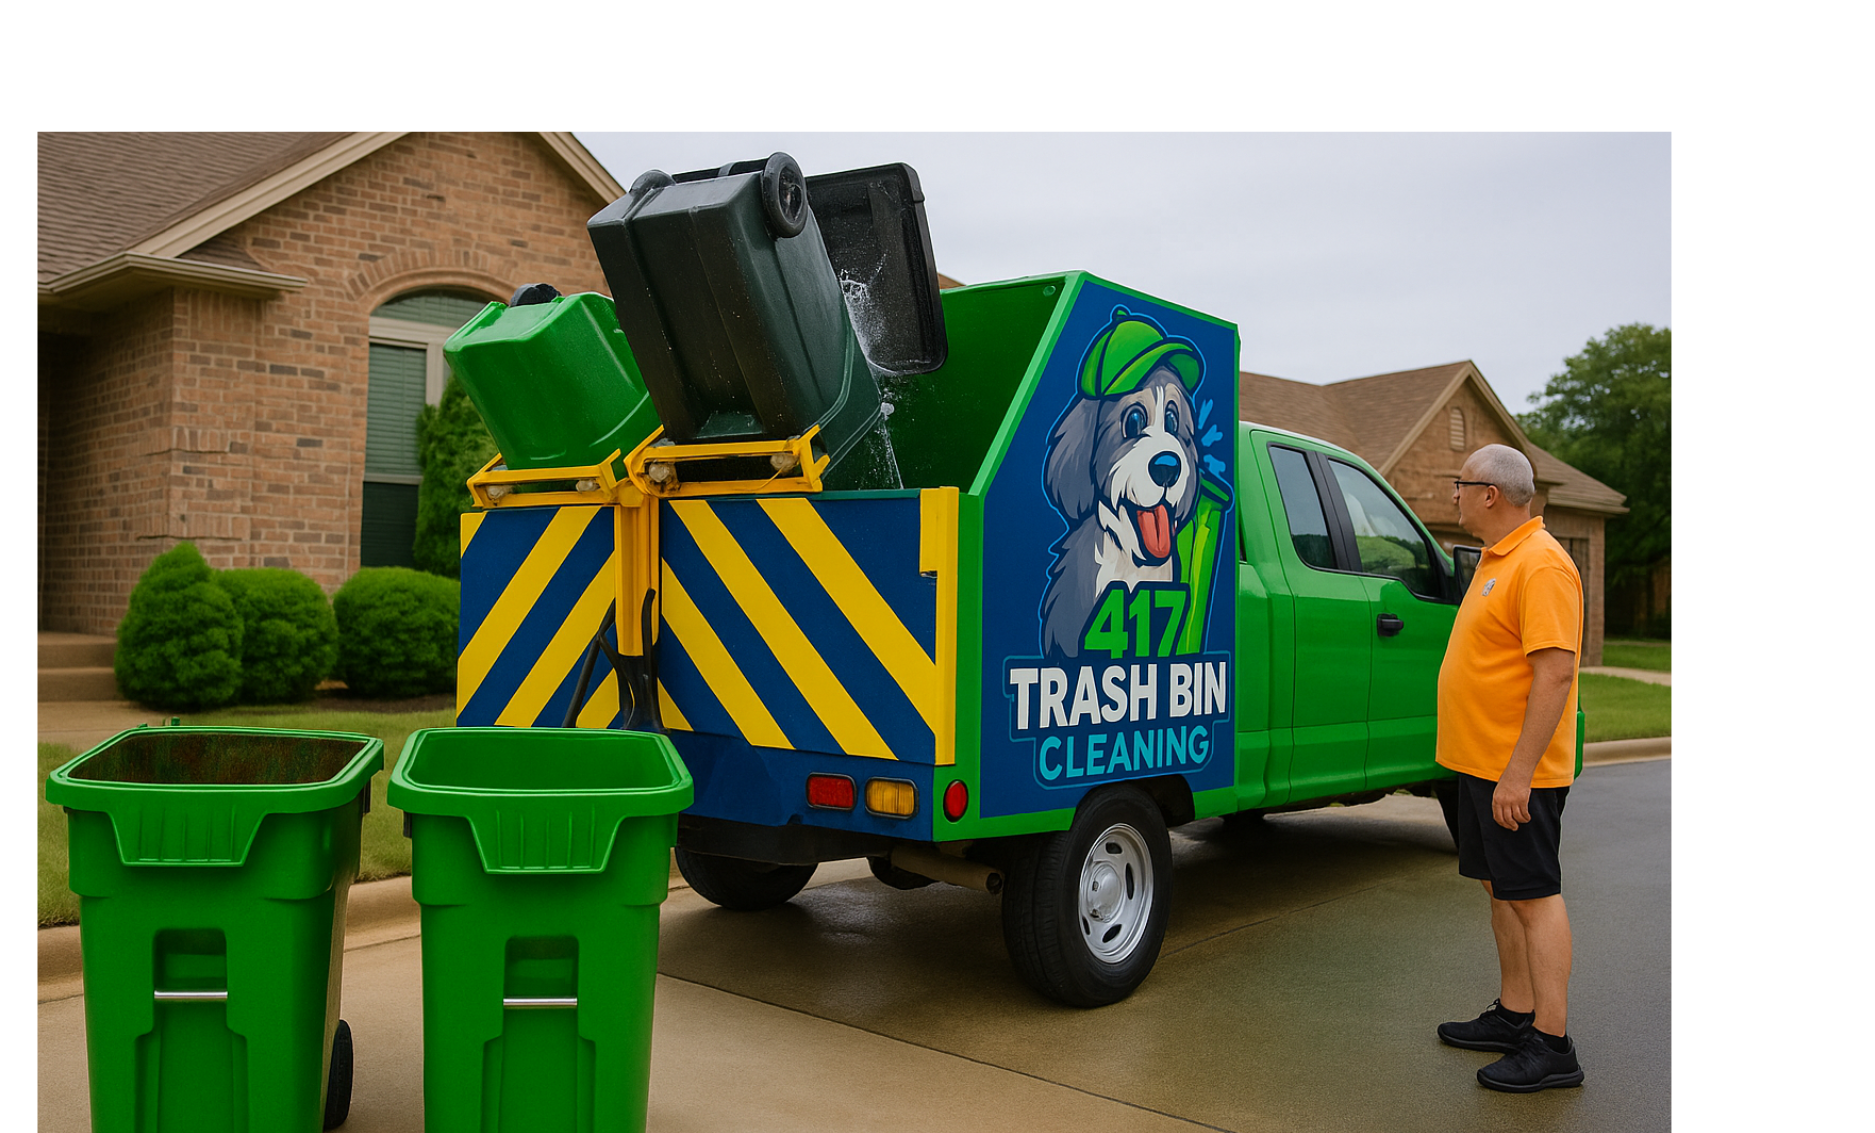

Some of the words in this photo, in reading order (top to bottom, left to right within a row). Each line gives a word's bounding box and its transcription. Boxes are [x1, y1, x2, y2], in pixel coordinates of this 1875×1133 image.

[1084, 589, 1187, 659] 417
[1010, 663, 1158, 729] TRASH
[1169, 661, 1226, 718] BIN
[1039, 725, 1210, 780] CLEANING
